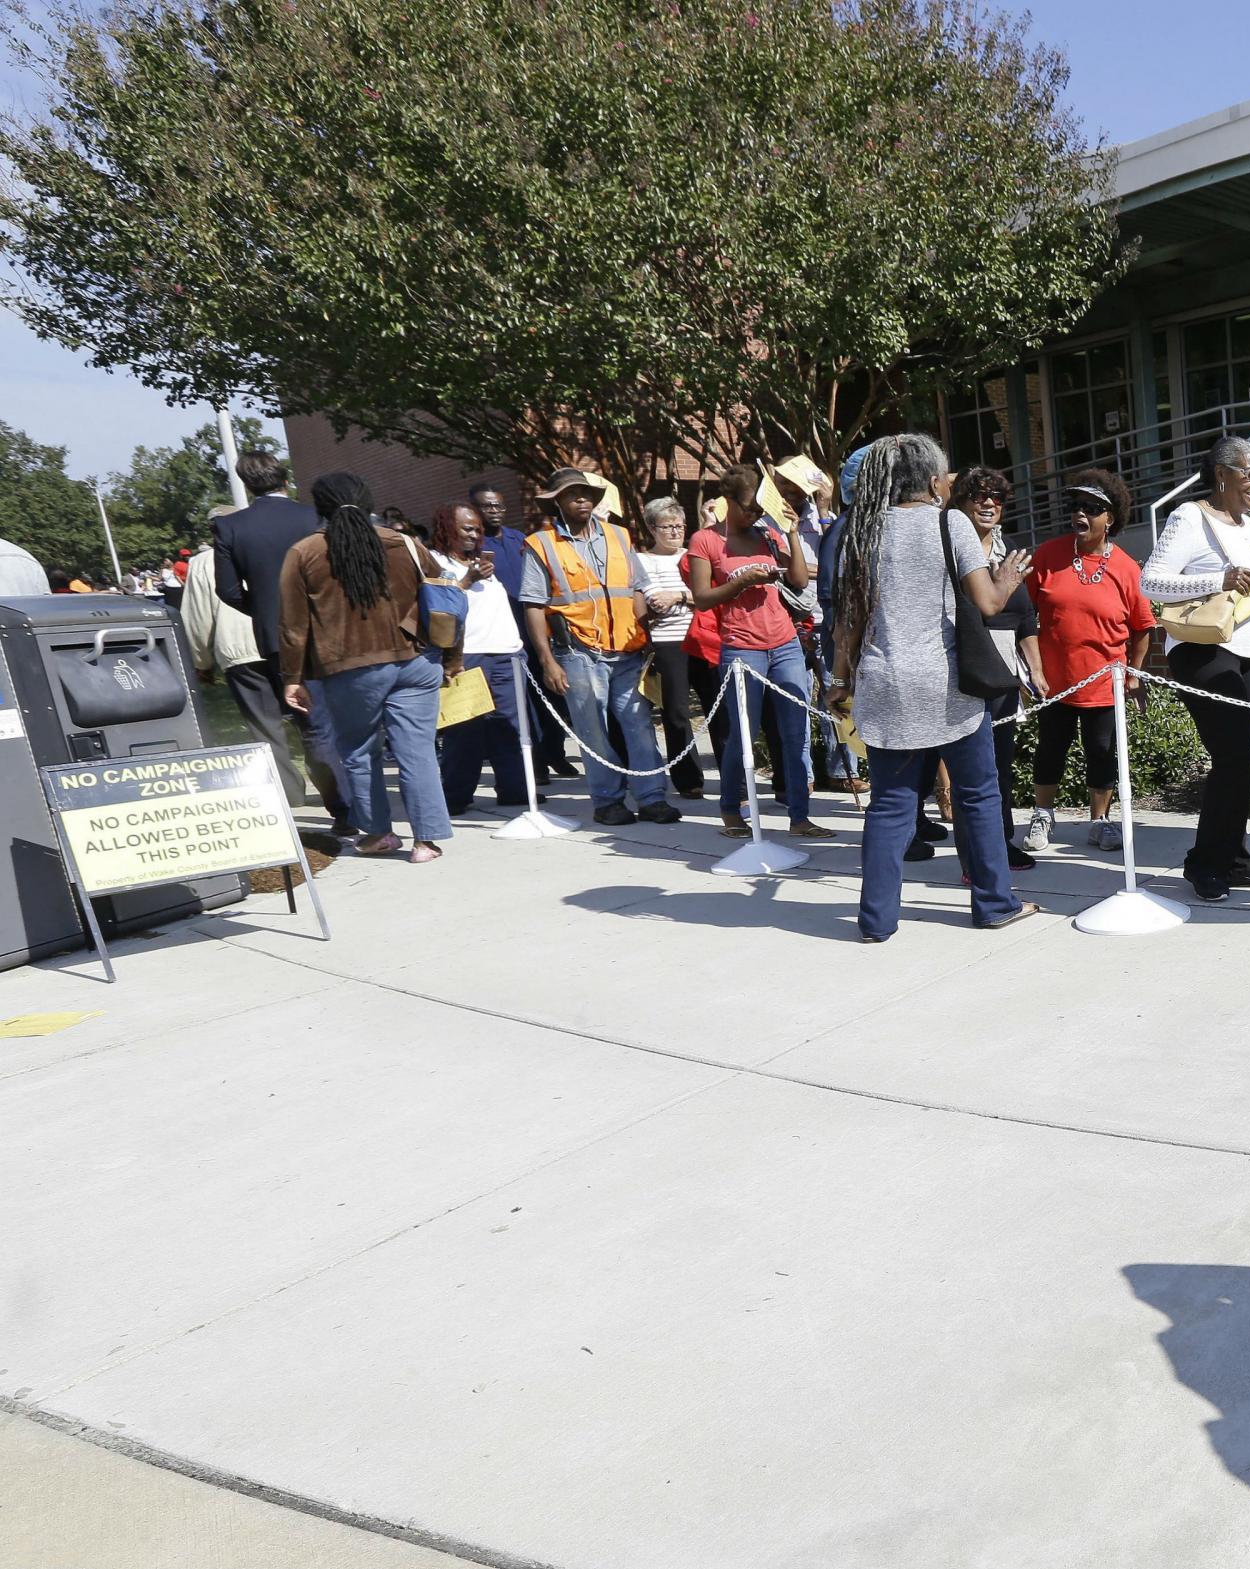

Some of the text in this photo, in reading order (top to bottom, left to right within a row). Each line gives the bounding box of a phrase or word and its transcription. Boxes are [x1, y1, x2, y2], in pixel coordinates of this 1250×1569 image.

[60, 773, 97, 790] NO
[139, 777, 201, 797] ZONE
[89, 797, 261, 832] NO CAMPAIGNING
[85, 814, 278, 854] ALLOWED BEYOND
[136, 837, 241, 863] THIS POINT
